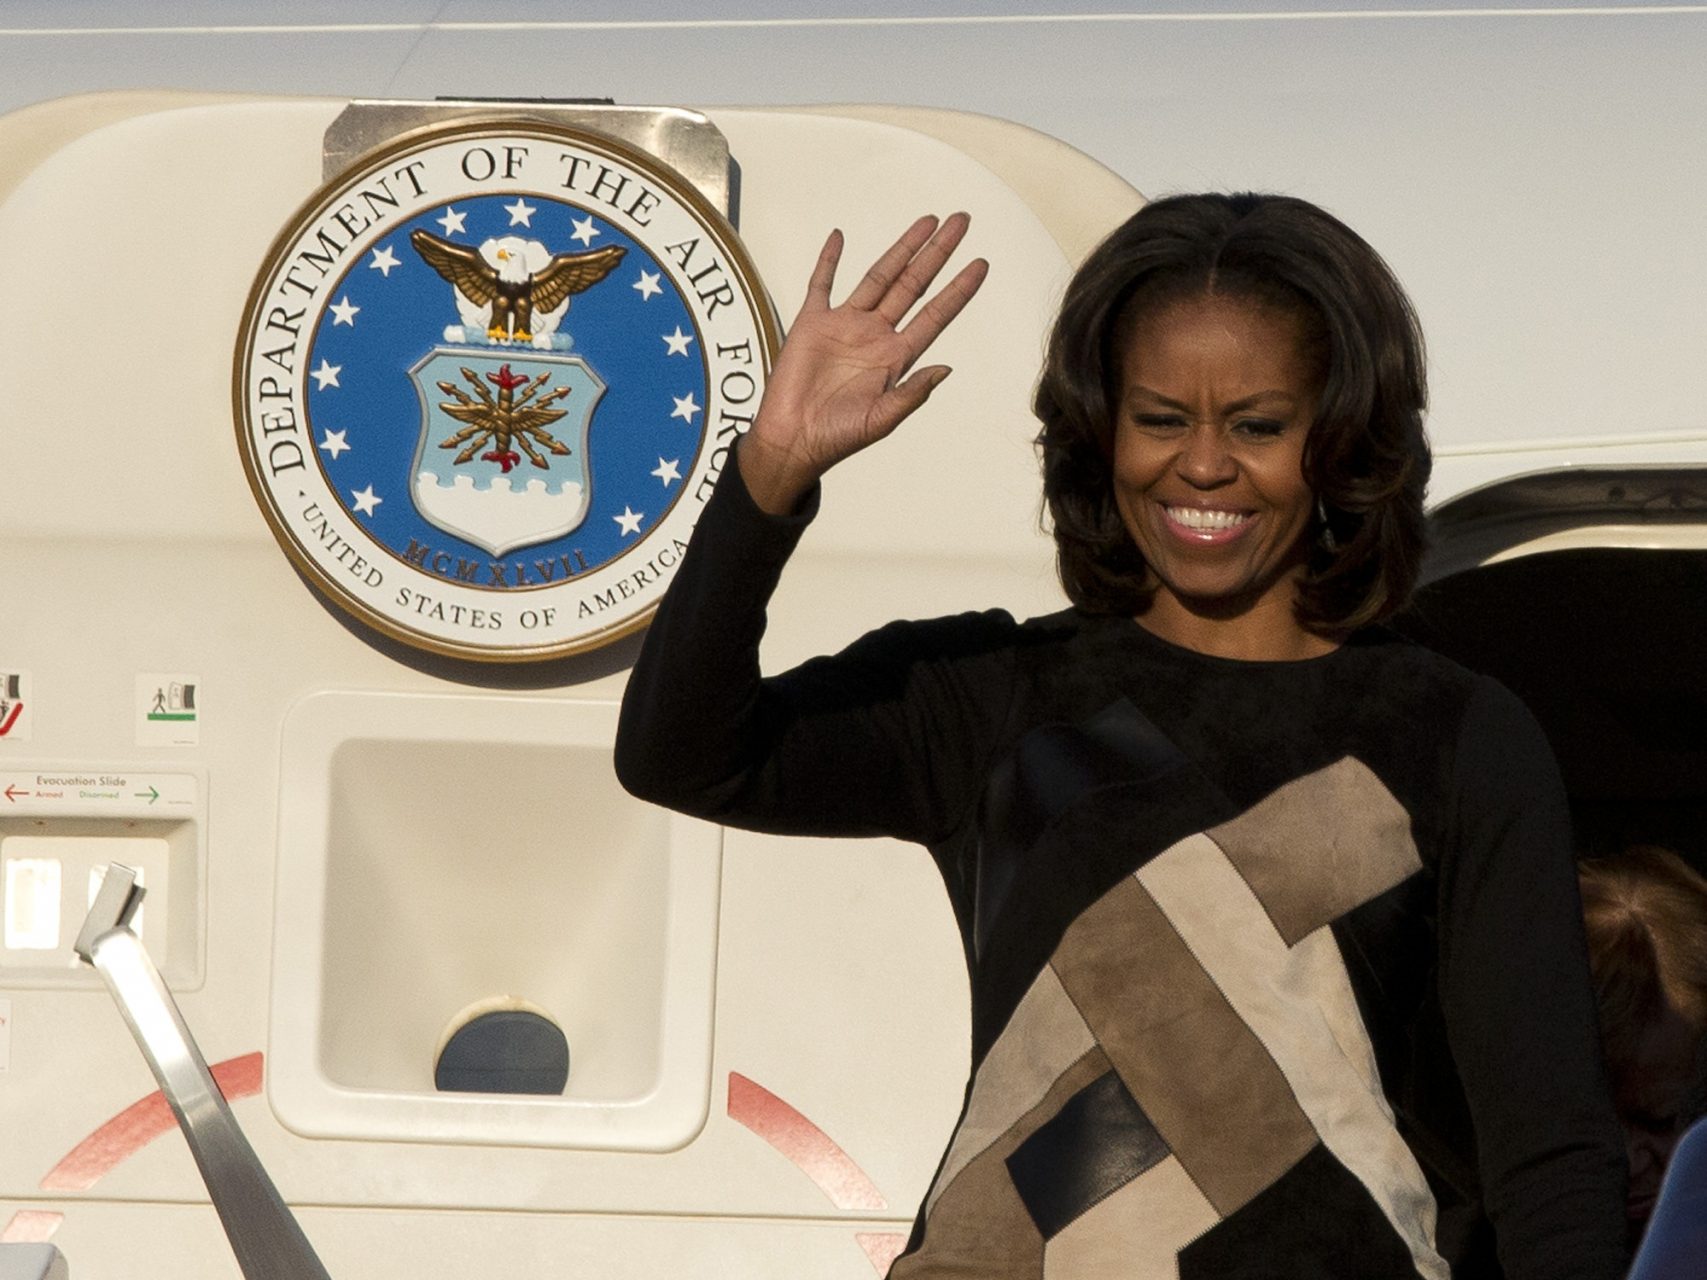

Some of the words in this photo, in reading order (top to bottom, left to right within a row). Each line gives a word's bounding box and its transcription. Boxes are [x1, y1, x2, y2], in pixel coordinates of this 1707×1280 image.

[258, 161, 428, 477] DEPARTMENT
[460, 146, 530, 183] OF
[558, 153, 662, 228] THE
[664, 236, 736, 321] AIR
[302, 502, 384, 588] UNITED
[396, 587, 503, 630] STATES
[520, 608, 557, 629] OF
[578, 539, 689, 619] AMERICA
[402, 536, 589, 588] MCMXLVII
[35, 790, 64, 798] Armed
[79, 790, 120, 799] Disarmed
[36, 776, 96, 786] Evacuation
[99, 776, 127, 786] Slide
